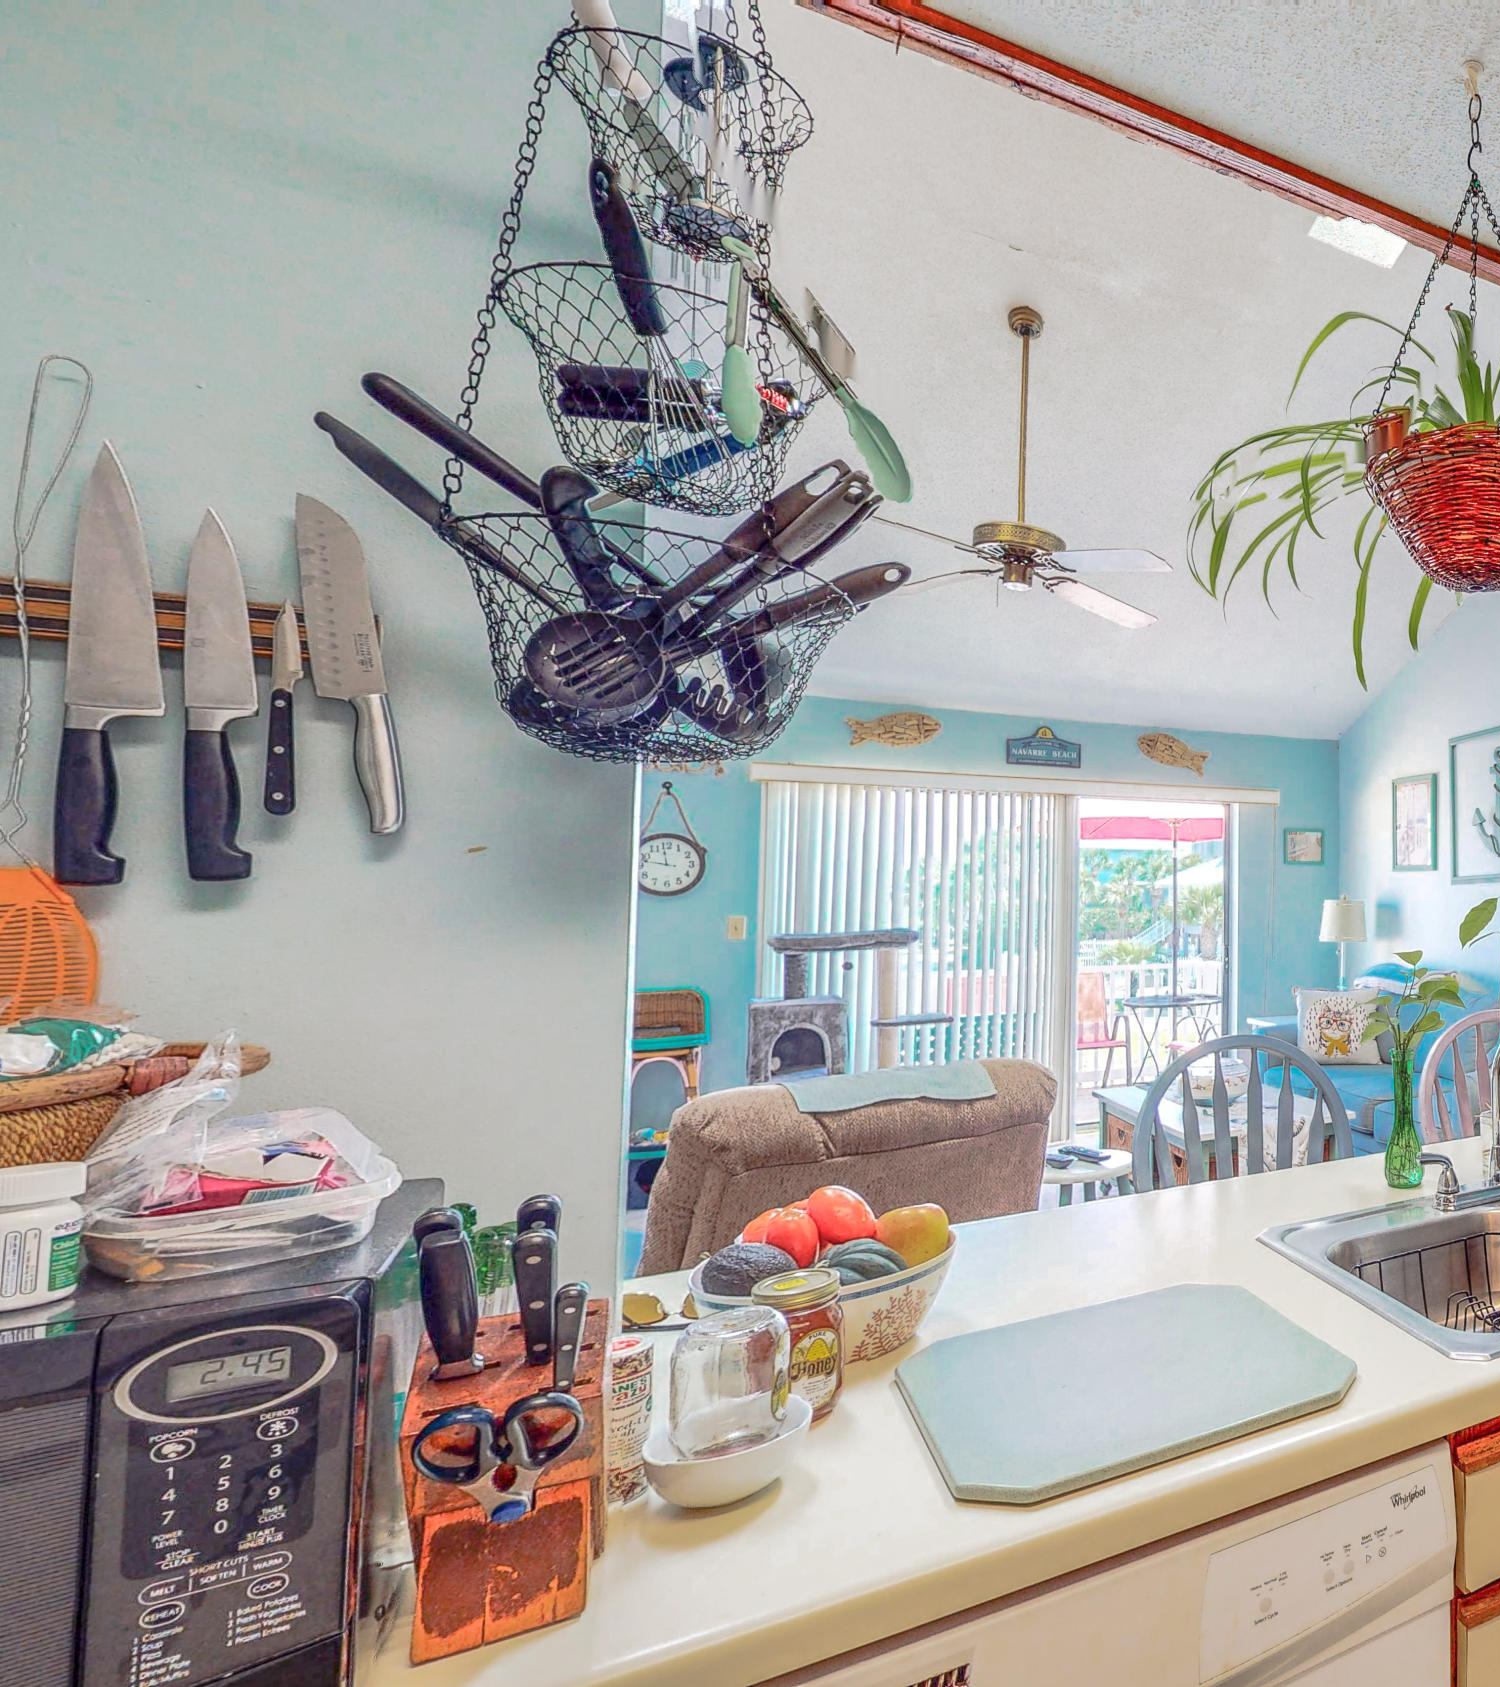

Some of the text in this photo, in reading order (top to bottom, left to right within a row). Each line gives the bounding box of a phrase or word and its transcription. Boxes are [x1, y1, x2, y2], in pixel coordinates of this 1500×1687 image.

[1012, 748, 1077, 759] NAVARRE BEACH
[650, 845, 659, 853] 11
[662, 842, 672, 850] 12
[684, 851, 691, 859] 2
[689, 861, 695, 869] 3
[641, 872, 648, 880] 8
[676, 877, 682, 885] 5
[684, 870, 690, 878] 4
[664, 880, 670, 888] 6
[808, 1331, 827, 1341] PURE
[790, 1355, 837, 1381] Honey
[612, 1376, 648, 1394] ANES
[259, 1406, 300, 1420] DEFROST
[149, 1428, 198, 1443] POPCORN
[271, 1445, 282, 1458] 3
[219, 1454, 232, 1469] 2
[165, 1466, 175, 1480] 1
[268, 1464, 282, 1479] 6
[216, 1475, 231, 1491] 5
[161, 1488, 177, 1502] 4
[268, 1485, 281, 1500] 9
[1390, 1485, 1426, 1509] Whirlpool
[215, 1497, 229, 1512] 8
[161, 1509, 176, 1525] 7
[258, 1512, 287, 1524] CLOCK
[214, 1519, 228, 1534] 0
[152, 1529, 184, 1543] POWER
[155, 1538, 179, 1549] LEVEL
[161, 1555, 195, 1570] CLEAR
[165, 1549, 191, 1562] STOP
[253, 1558, 283, 1571] WARM
[200, 1569, 237, 1585] SOFTEN
[150, 1584, 177, 1598] MELT
[252, 1580, 282, 1594] COOK
[143, 1607, 181, 1623] REHEAT
[141, 1641, 164, 1653] Soup
